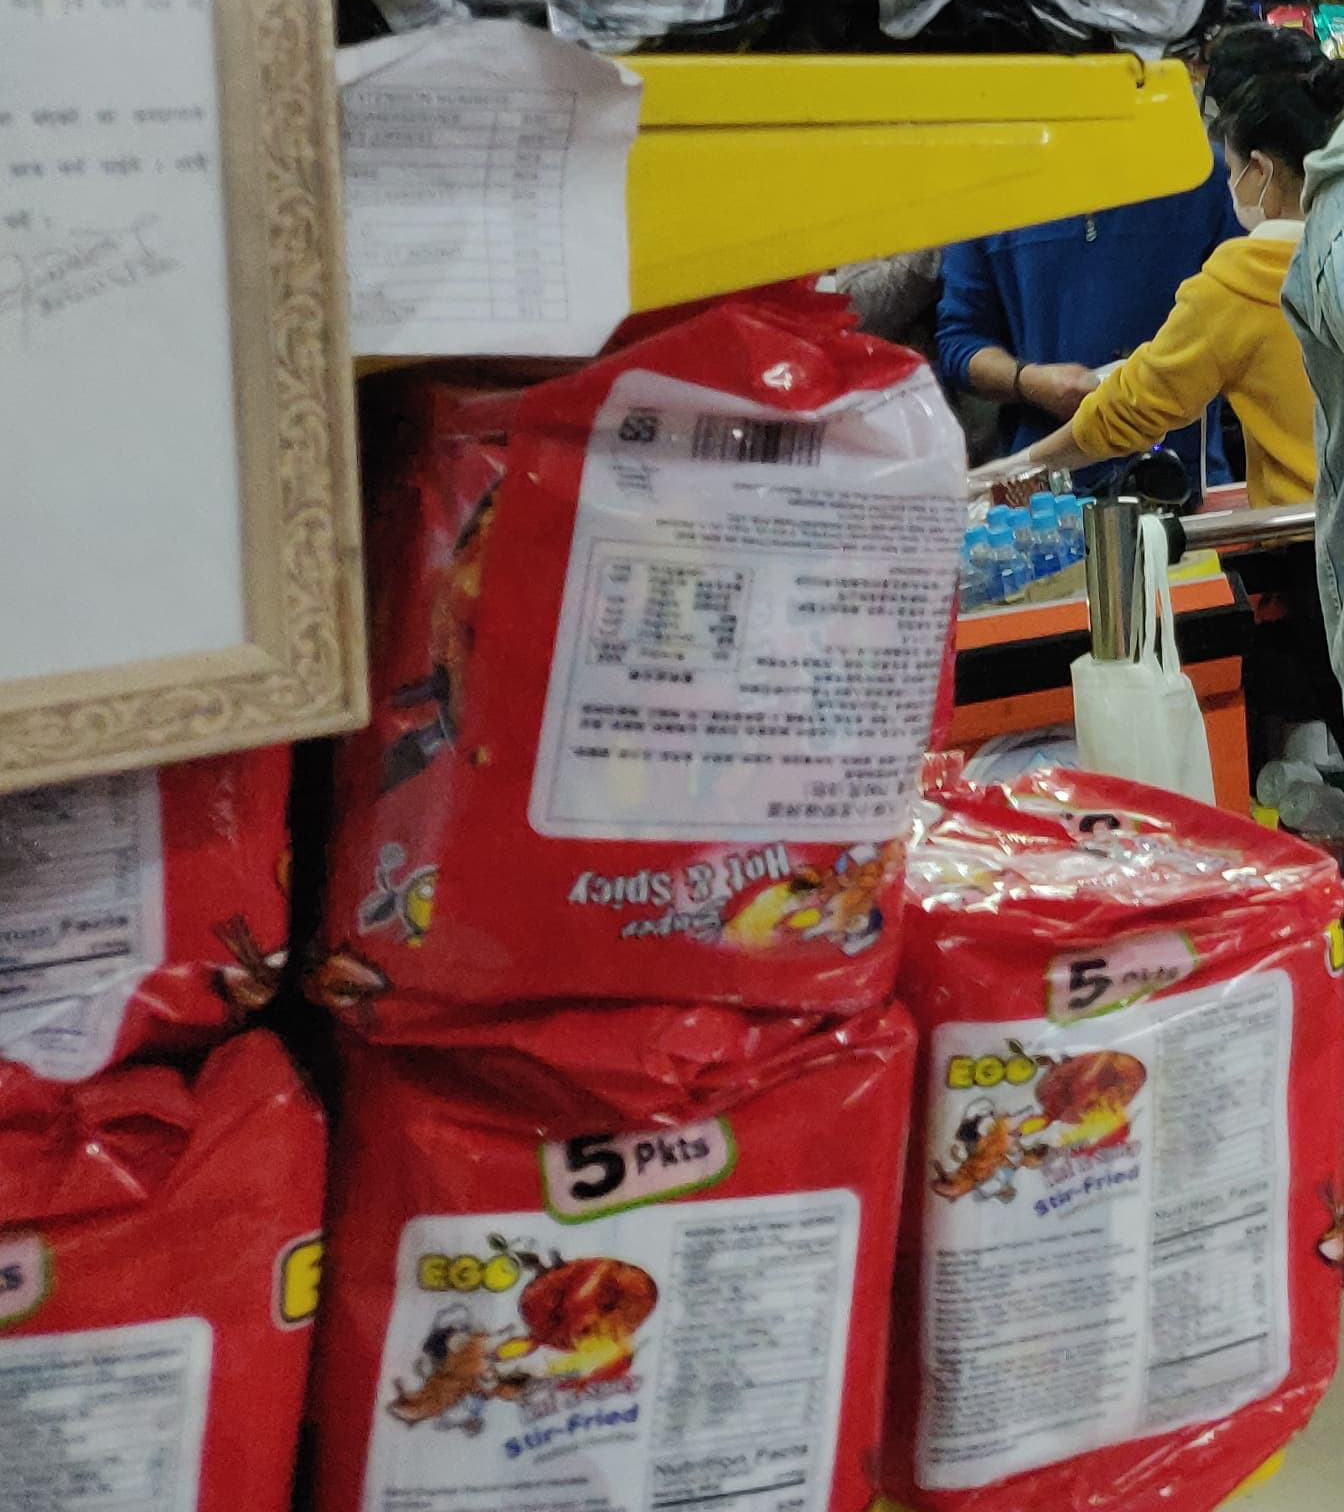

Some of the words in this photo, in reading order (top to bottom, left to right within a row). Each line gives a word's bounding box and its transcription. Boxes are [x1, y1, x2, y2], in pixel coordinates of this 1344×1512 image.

[1068, 959, 1114, 1010] 5
[565, 1132, 627, 1201] 5
[635, 1129, 710, 1175] Pkts
